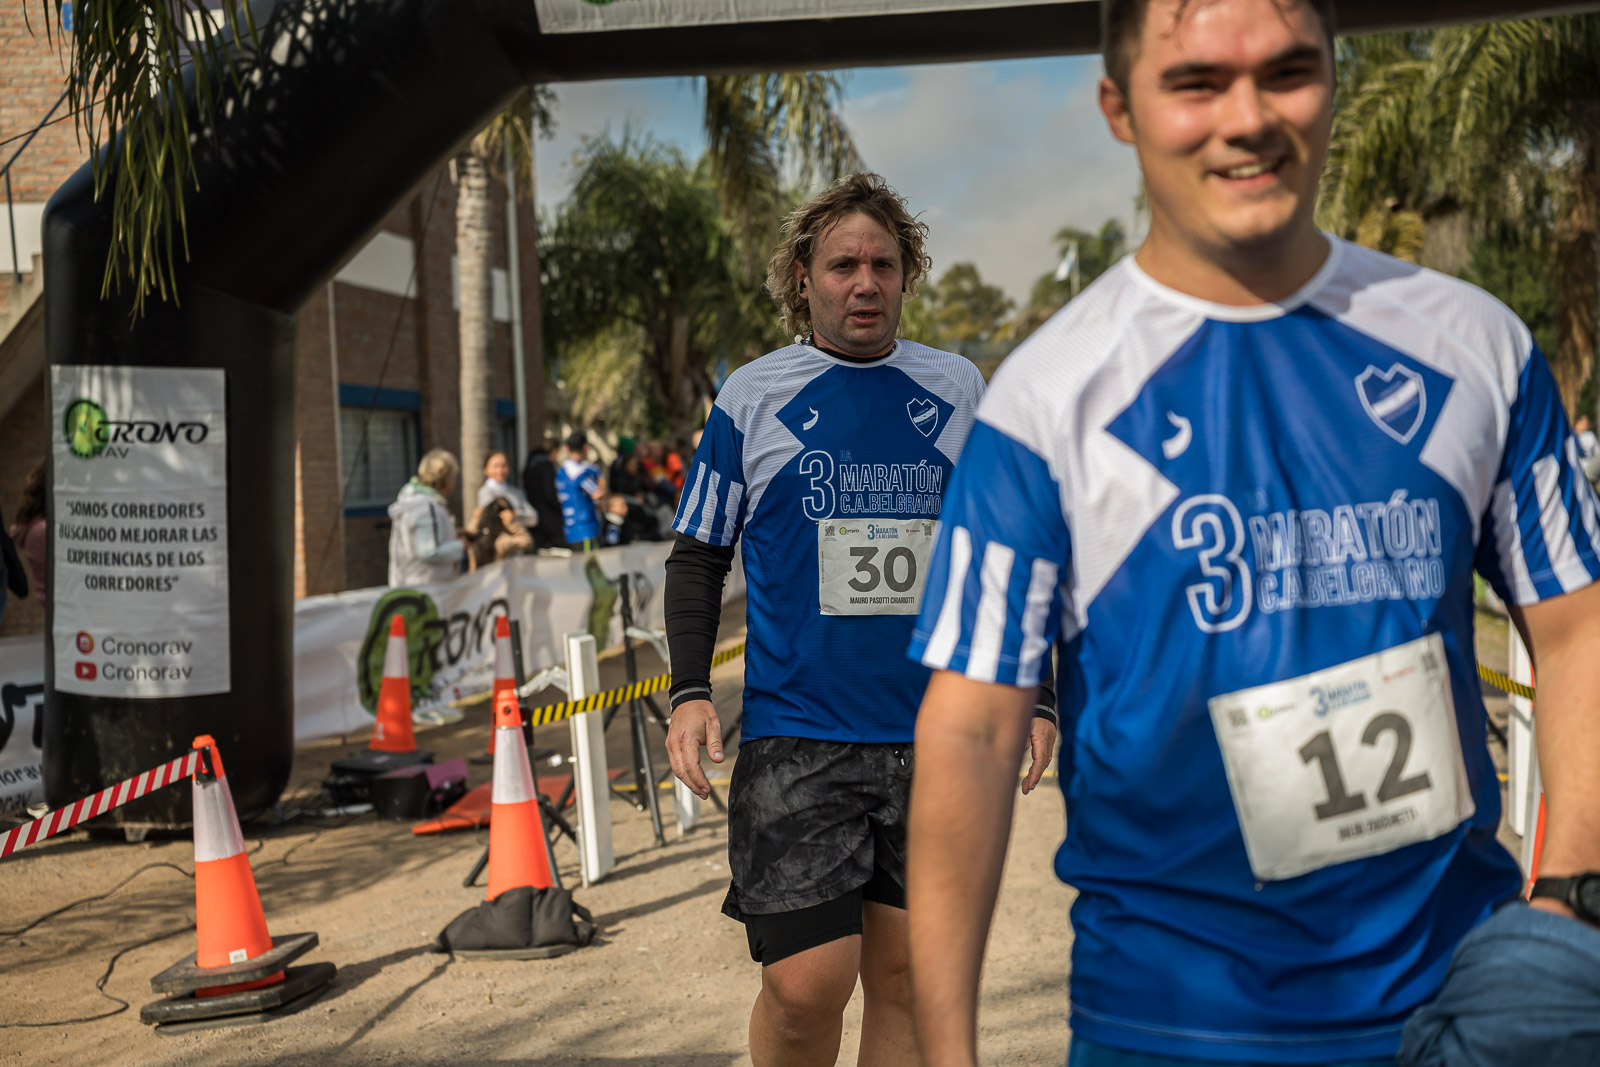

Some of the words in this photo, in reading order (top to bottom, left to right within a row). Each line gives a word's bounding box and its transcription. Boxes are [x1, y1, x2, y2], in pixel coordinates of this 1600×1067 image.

[799, 450, 836, 520] 3
[839, 459, 943, 494] MARATÓN
[111, 502, 205, 519] CORREDORES
[840, 493, 942, 515] C.A.BELGRANO
[58, 523, 117, 543] BUSCANDO
[120, 527, 188, 543] MEJORAR
[192, 526, 218, 542] LAS
[867, 523, 876, 540] 3
[66, 548, 153, 568] EXPERIENCIAS
[156, 551, 176, 567] DE
[179, 550, 206, 567] LOS
[1171, 494, 1253, 634] 3
[847, 546, 917, 593] 30
[849, 597, 869, 605] MAURO
[869, 597, 890, 605] PASOTTI
[101, 636, 193, 656] Cronorav
[101, 661, 193, 681] Cronorav
[1299, 711, 1431, 821] 12
